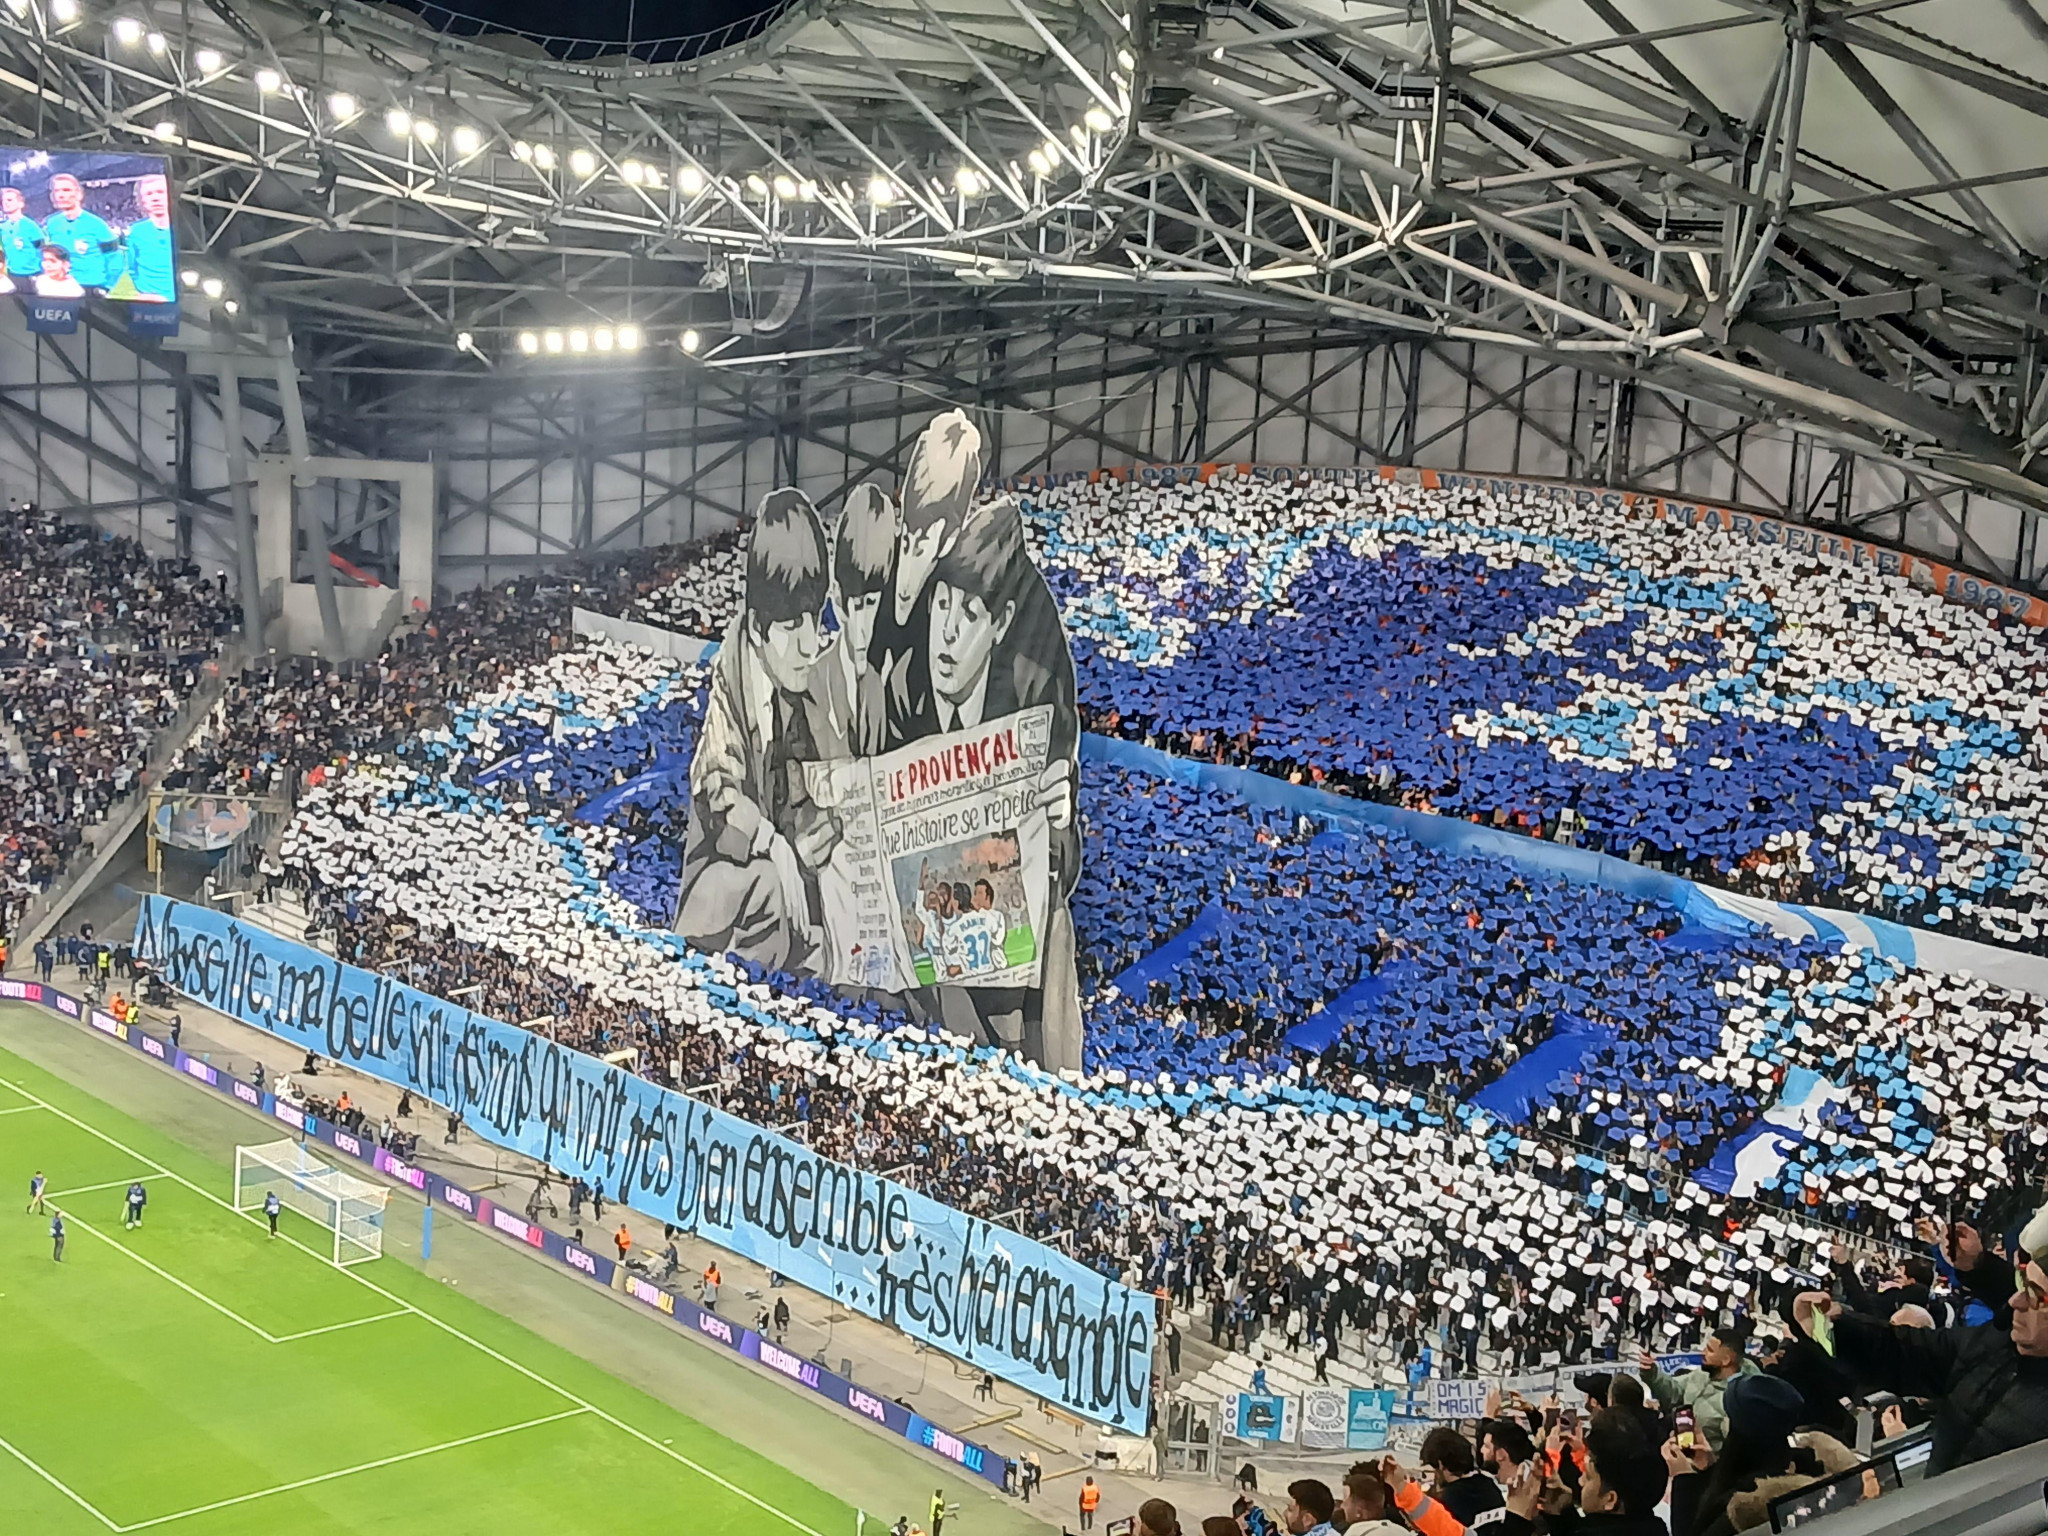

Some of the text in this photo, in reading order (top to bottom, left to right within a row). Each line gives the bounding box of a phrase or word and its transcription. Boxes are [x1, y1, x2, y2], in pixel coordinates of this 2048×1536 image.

[34, 308, 72, 321] UEFA
[1127, 465, 1200, 486] 1987
[1665, 501, 1901, 575] MARSEILLE
[1944, 570, 2032, 616] 1987
[889, 769, 905, 802] LE
[908, 728, 1019, 795] PROVENÇAL
[880, 828, 901, 860] Que
[960, 807, 980, 835] se
[56, 994, 78, 1016] UEFA
[142, 1035, 165, 1059] UEFA
[234, 1080, 259, 1106] UEFA
[274, 960, 326, 1033] ma
[325, 961, 406, 1061] belle
[576, 1066, 629, 1180] vont
[618, 1090, 678, 1206] très
[676, 1100, 738, 1234] bien
[334, 1131, 361, 1157] UEFA
[445, 1185, 473, 1214] UEFA
[527, 1225, 545, 1249] ALL
[565, 1245, 596, 1275] UEFA
[699, 1312, 733, 1344] UEFA
[953, 1216, 1012, 1360] bien
[1011, 1265, 1149, 1425] ensemble
[759, 1340, 820, 1389] WELCOME ALL
[848, 1387, 886, 1423] UEFA
[1437, 1382, 1462, 1398] OM
[922, 1425, 984, 1473] #FOOTBALL
